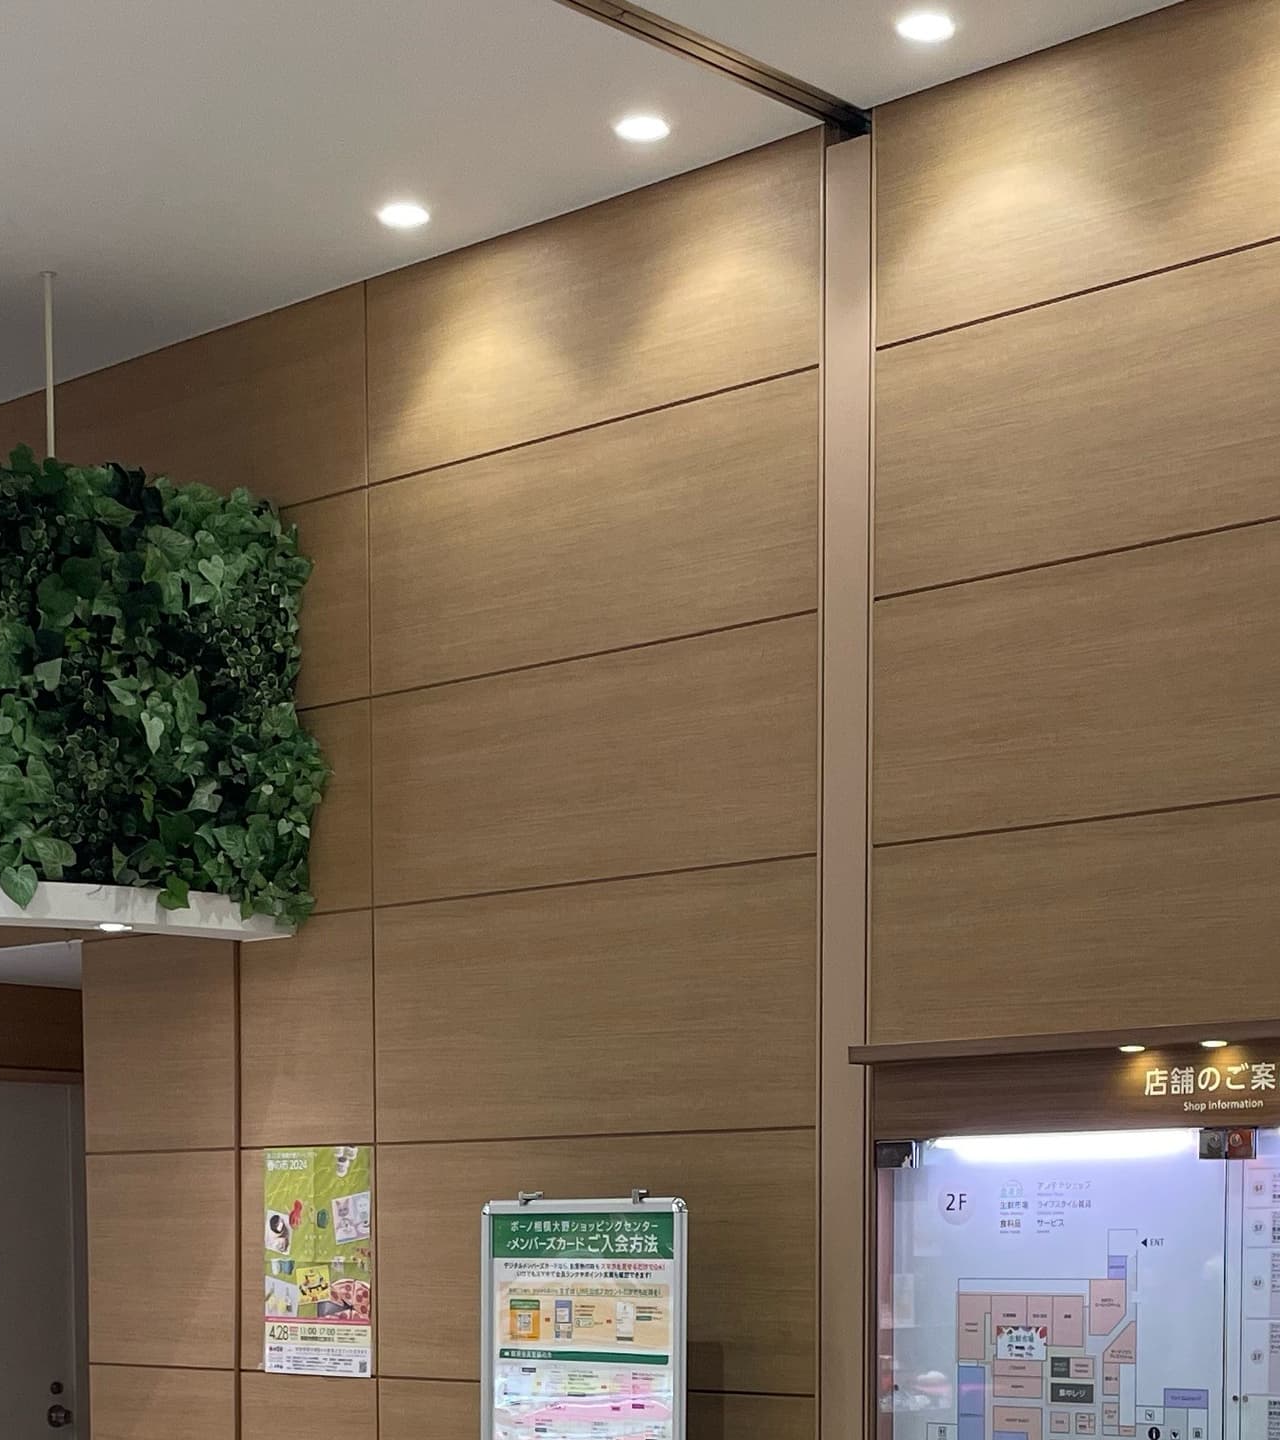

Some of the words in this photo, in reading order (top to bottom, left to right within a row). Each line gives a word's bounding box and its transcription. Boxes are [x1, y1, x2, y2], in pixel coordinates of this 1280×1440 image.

[1183, 1101, 1207, 1112] Shop
[945, 1193, 968, 1211] 2F
[588, 1234, 659, 1254] ご入会方法
